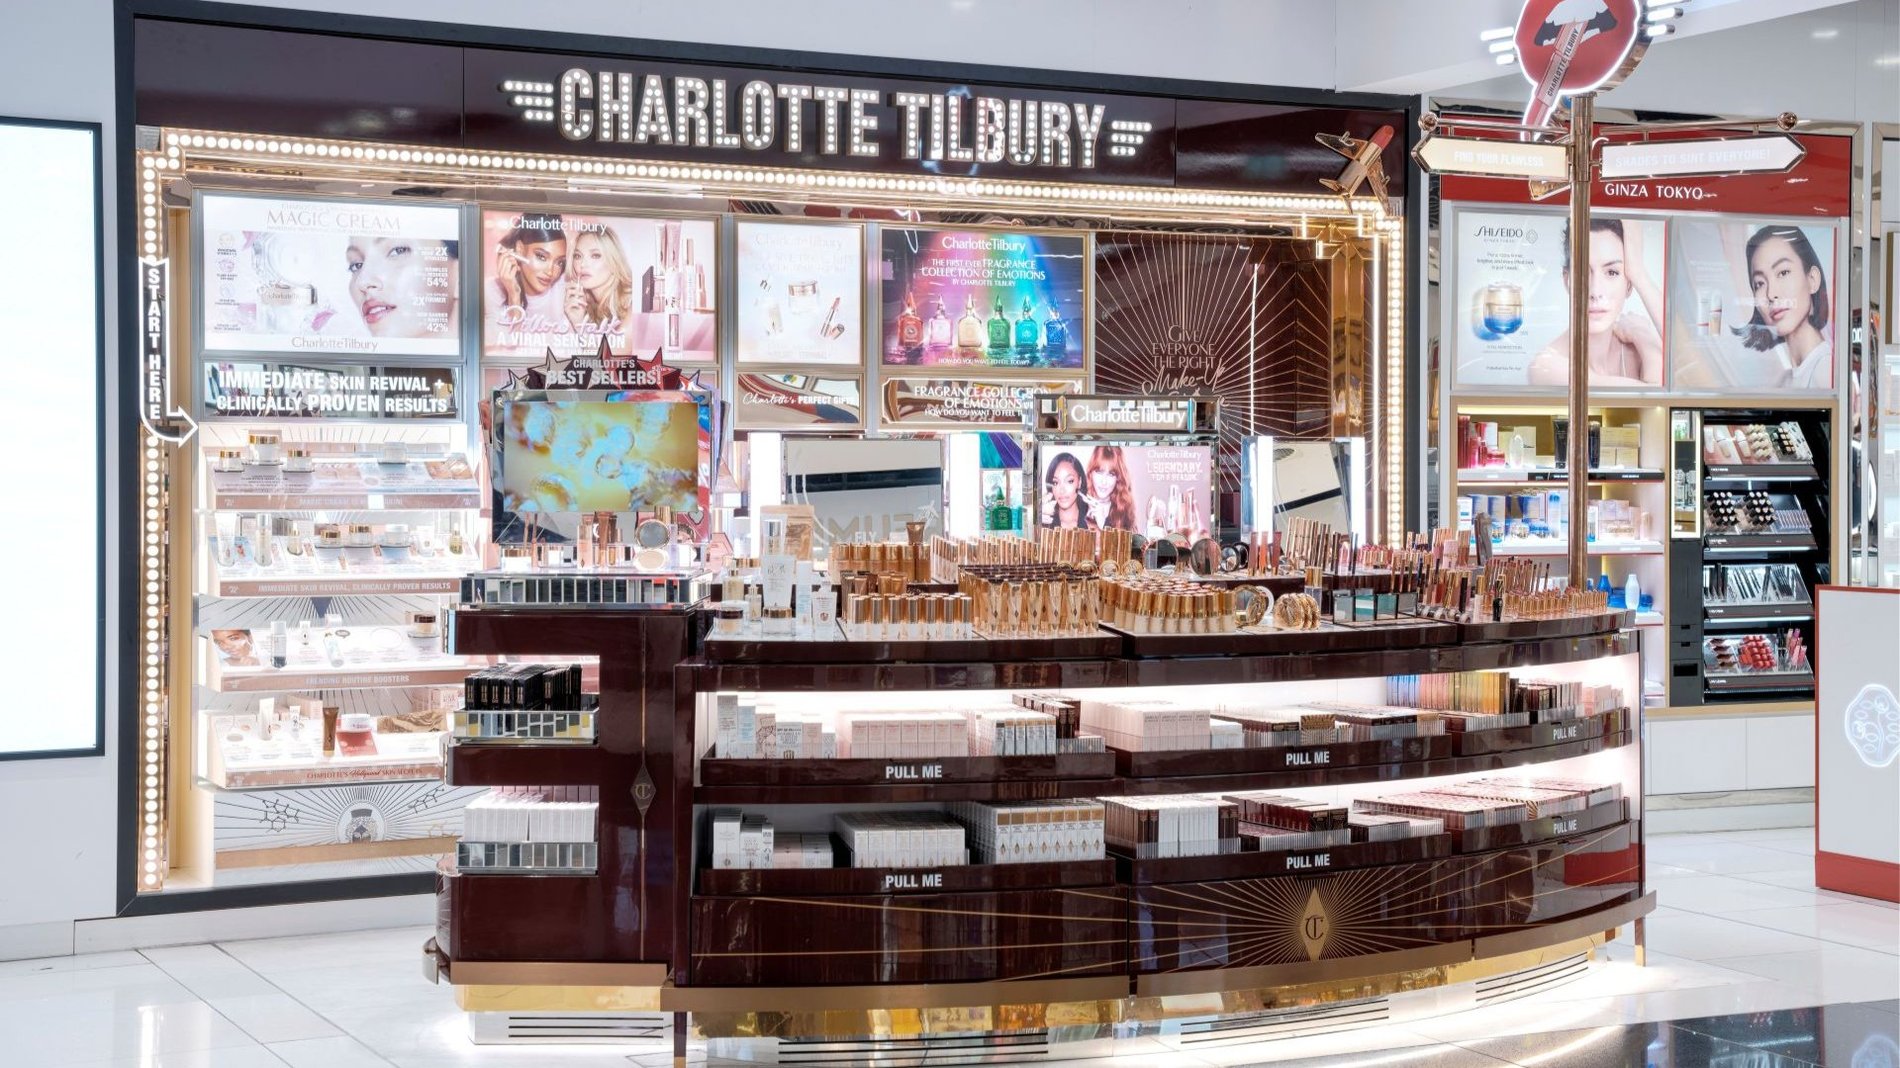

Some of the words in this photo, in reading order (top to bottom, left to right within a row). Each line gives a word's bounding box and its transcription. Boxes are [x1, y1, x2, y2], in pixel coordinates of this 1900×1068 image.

[1547, 57, 1569, 96] CHARLOTTE
[1564, 28, 1579, 57] TILBURY
[560, 68, 880, 157] CHARLOTTE
[896, 92, 1106, 168] TILBURY
[1615, 157, 1659, 168] SHADES
[1663, 155, 1677, 164] TO
[1680, 153, 1705, 163] SUIT
[1708, 149, 1770, 162] EVERYONE!
[1605, 183, 1648, 197] GINZA
[1656, 186, 1703, 199] TOKYO
[267, 209, 331, 227] MAGIC
[336, 211, 401, 230] CREAM
[1473, 226, 1523, 237] SHISEIDO
[434, 247, 448, 256] 2X
[946, 259, 963, 267] FIRST
[983, 259, 1036, 269] FRAGRANCE
[922, 267, 980, 278] COLLECTION
[982, 269, 994, 278] OF
[997, 270, 1046, 280] EMOTIONS
[426, 277, 448, 287] 54%
[147, 268, 161, 349] START
[426, 322, 448, 332] 42%
[497, 332, 506, 347] A
[510, 333, 547, 347] VIRAL
[553, 335, 625, 348] SENSATON
[1152, 343, 1216, 355] EVERYONE
[573, 359, 635, 369] CHARLOTTE'S
[1152, 356, 1176, 369] THE
[1179, 356, 1216, 369] RIGHT
[219, 370, 325, 390] IMMEDIATE
[330, 375, 365, 390] SKIN
[370, 376, 430, 391] REVIVAL
[435, 379, 445, 389] +
[546, 370, 585, 386] BEST
[591, 370, 662, 386] SELLERS!
[149, 355, 161, 420] HERE
[914, 387, 981, 398] FRAGRANCE
[983, 387, 1051, 398] COLLECTION
[217, 395, 302, 411] CLINICALLY
[308, 395, 379, 412] PROVEN
[385, 398, 448, 413] RESULTS
[798, 395, 831, 404] PERFECT
[945, 398, 961, 409] OF
[963, 398, 1022, 409] EMOTIONS
[374, 675, 409, 683] BOOSTERS
[1553, 727, 1566, 740] PULL
[1567, 725, 1577, 738] ME
[1286, 752, 1311, 766] PULL
[1314, 751, 1330, 764] ME
[885, 765, 918, 779] PULL
[922, 765, 942, 778] ME
[1553, 821, 1566, 834] PULL
[1567, 819, 1577, 831] ME
[1286, 856, 1312, 869] PULL
[1314, 853, 1330, 867] ME
[885, 874, 918, 888] PULL
[922, 874, 942, 887] ME
